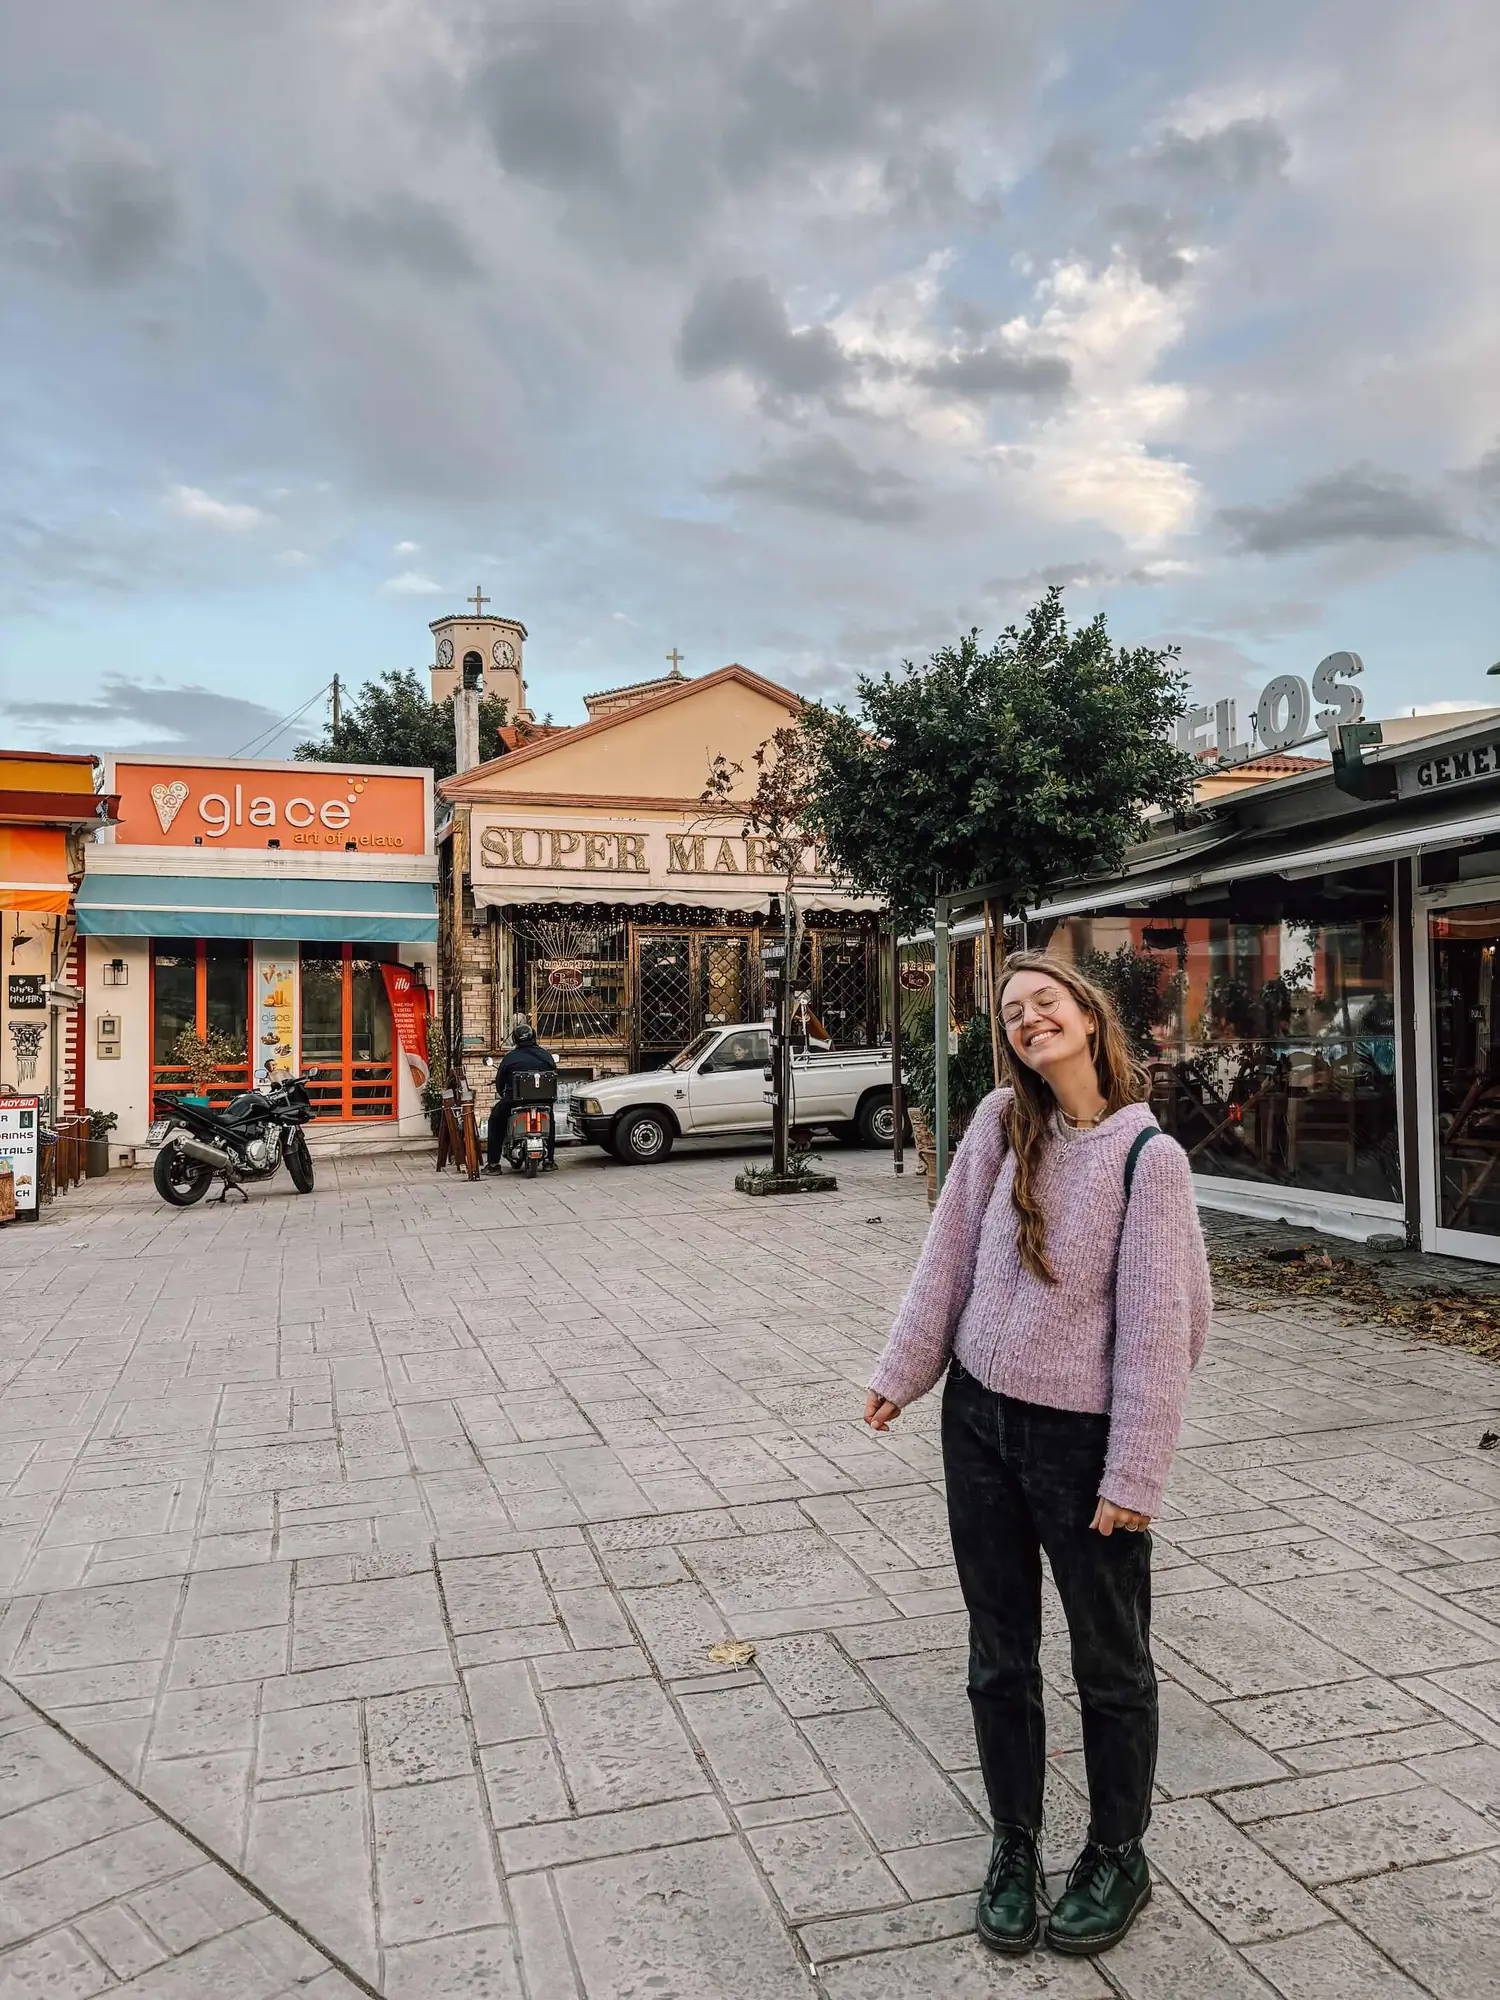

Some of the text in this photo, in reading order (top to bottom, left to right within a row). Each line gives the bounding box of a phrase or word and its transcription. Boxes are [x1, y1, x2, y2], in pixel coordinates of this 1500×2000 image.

[1170, 651, 1364, 764] ELOS
[198, 784, 351, 839] glace
[294, 830, 319, 844] art
[325, 831, 344, 845] of
[480, 826, 649, 873] SUPER
[394, 977, 410, 992] illy
[261, 1012, 290, 1025] glace
[0, 1131, 34, 1140] RINKS
